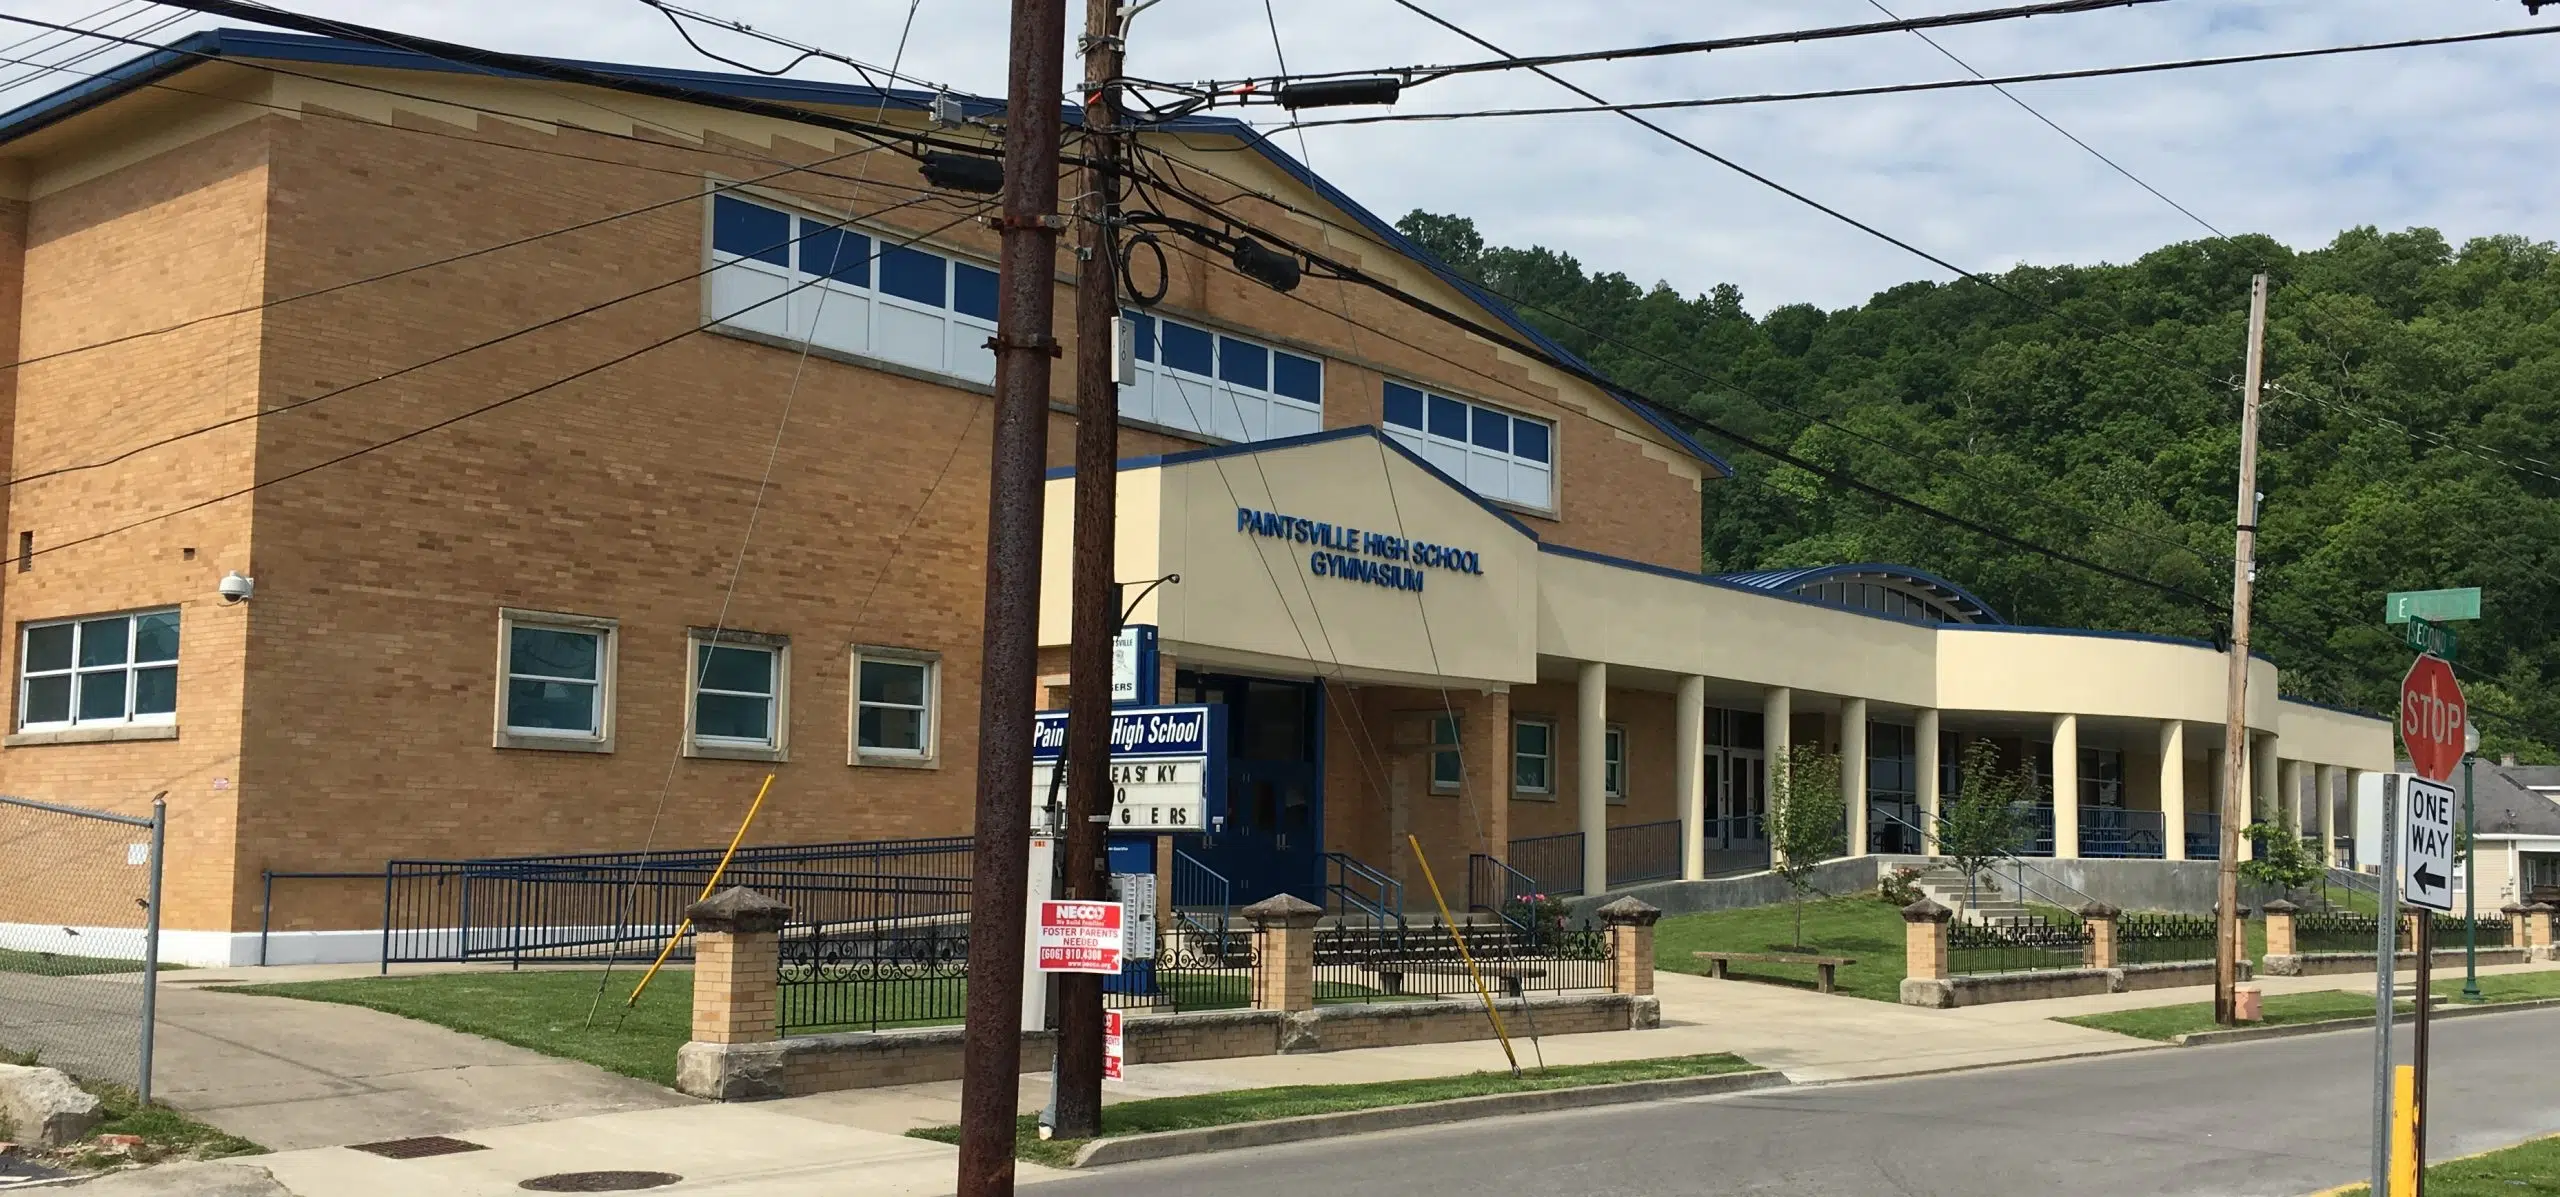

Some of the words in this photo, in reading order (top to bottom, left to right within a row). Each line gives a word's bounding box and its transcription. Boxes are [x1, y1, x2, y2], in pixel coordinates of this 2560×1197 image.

[1237, 508, 1360, 552] PAINTSVILLE
[1364, 531, 1409, 562] HIGH
[1412, 541, 1484, 576] SCHOOL
[1311, 551, 1424, 592] GYMNASIUM
[1114, 638, 1133, 647] SVILLE
[2410, 620, 2447, 653] SECOND
[1112, 682, 1133, 691] ERS
[1033, 720, 1065, 748] Pain
[1110, 717, 1144, 751] High
[1148, 714, 1202, 743] School
[2406, 690, 2461, 745] STOP
[1112, 766, 1148, 782] EAST
[1158, 765, 1177, 782] KY
[2413, 790, 2448, 826] ONE
[2412, 825, 2449, 860] WAY
[1056, 905, 1105, 920] NECCO
[1043, 928, 1076, 936] FOSTER
[1080, 928, 1118, 938] PARENTS
[1063, 937, 1098, 947] NEEDED
